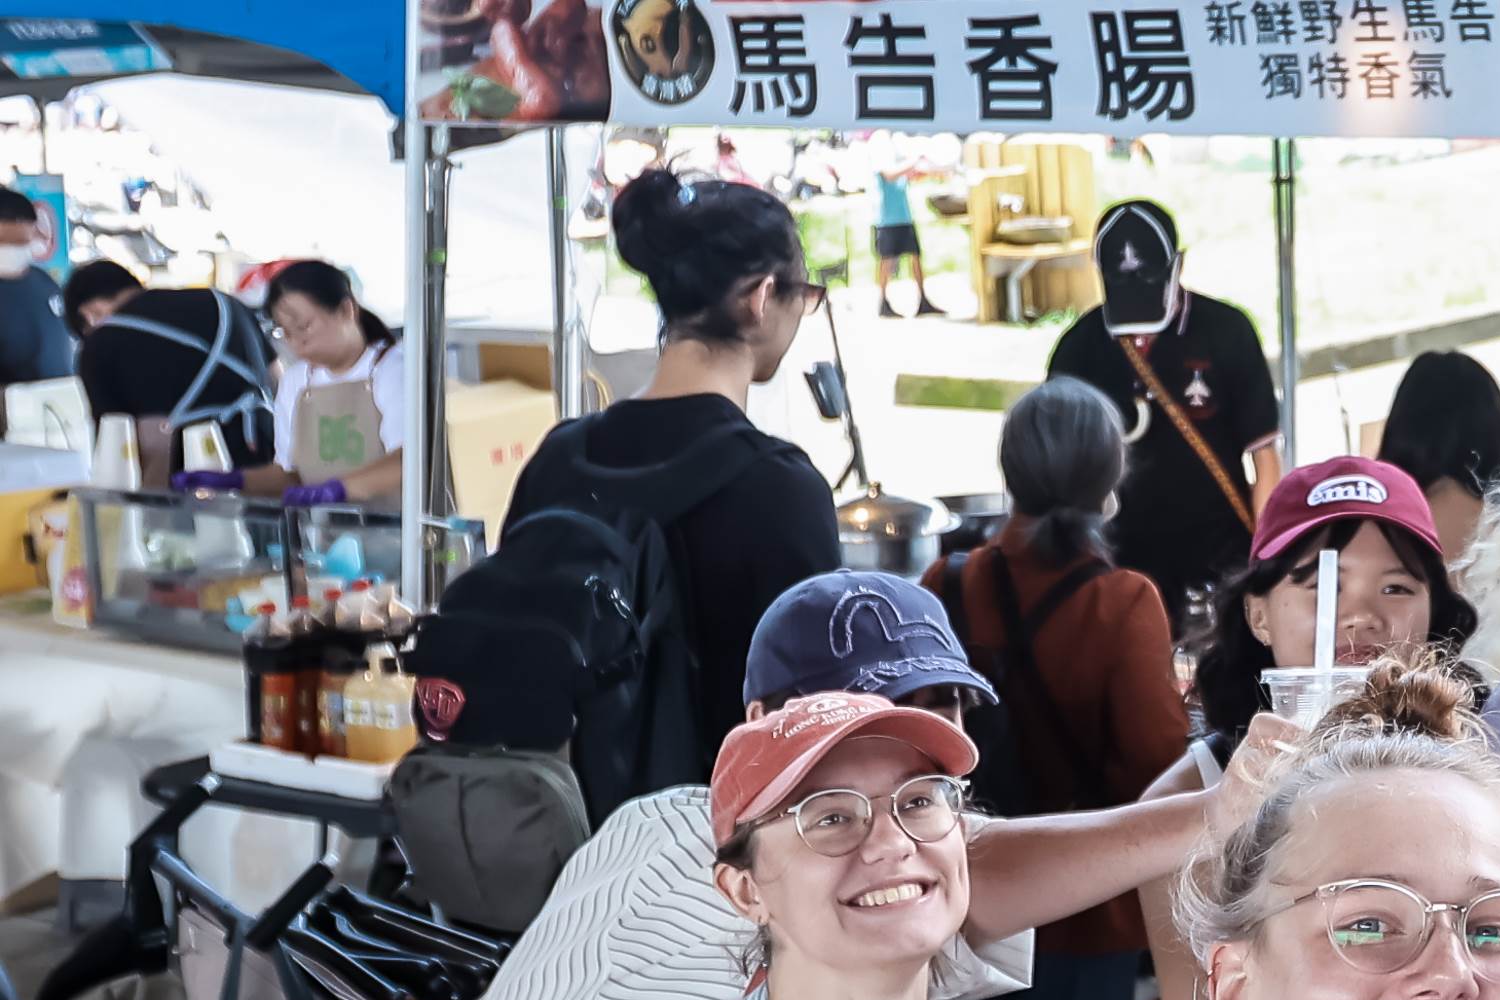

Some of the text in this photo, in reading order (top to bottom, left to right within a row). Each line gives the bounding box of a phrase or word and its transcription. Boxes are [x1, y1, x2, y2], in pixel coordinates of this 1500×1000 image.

[1204, 0, 1495, 46] 新鮮野生馬告
[727, 9, 1197, 121] 馬告香腸
[1259, 51, 1452, 99] 獨特香氣
